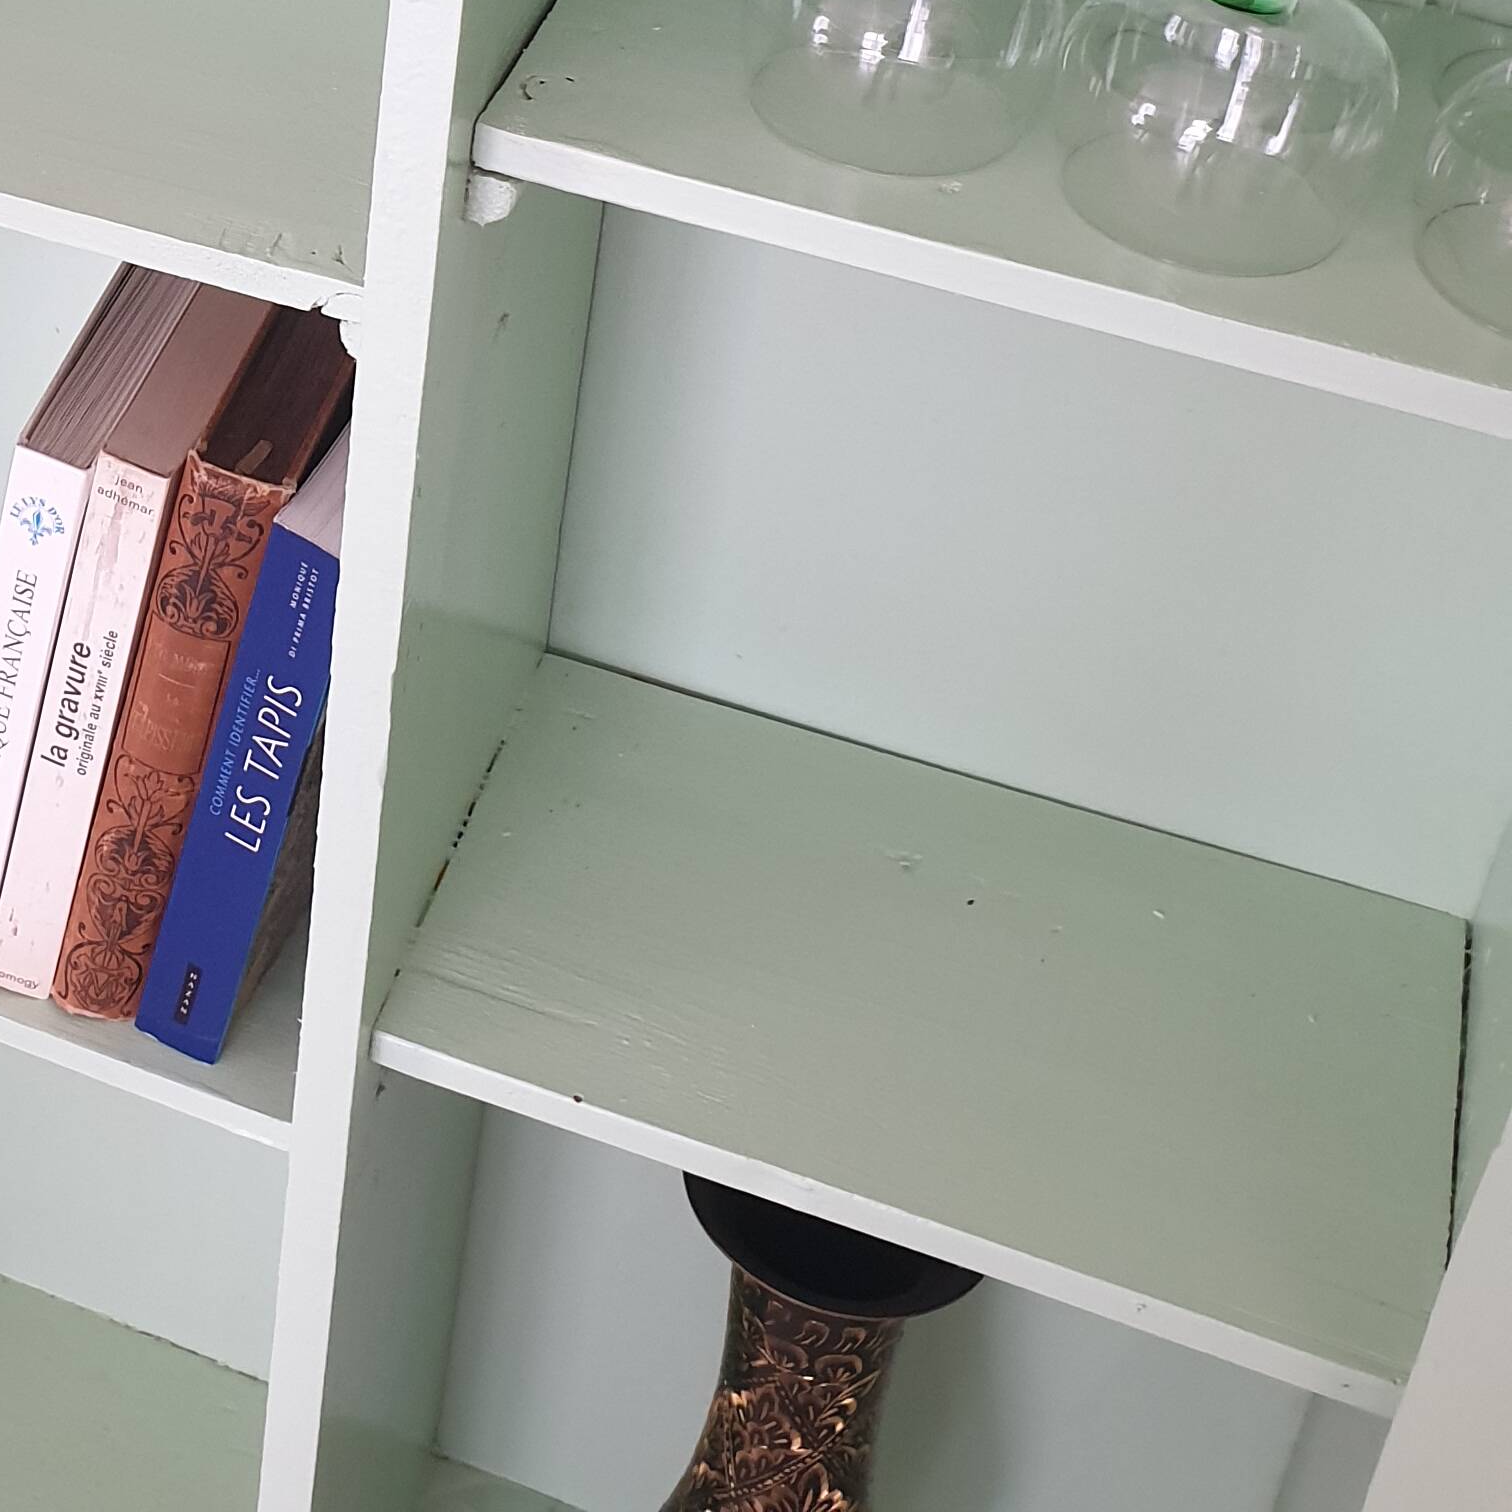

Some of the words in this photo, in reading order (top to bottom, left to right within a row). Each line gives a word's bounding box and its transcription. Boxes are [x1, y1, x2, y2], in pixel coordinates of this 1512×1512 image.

[115, 475, 143, 494] jean
[289, 561, 308, 608] MONIQUE
[288, 646, 297, 658] DI
[40, 744, 69, 767] la
[55, 642, 91, 741] gravure
[76, 722, 97, 776] originale
[90, 704, 101, 720] au
[99, 630, 118, 668] siècle
[243, 675, 302, 780] TAPIS
[209, 751, 237, 816] COMMENT
[224, 785, 271, 853] LES
